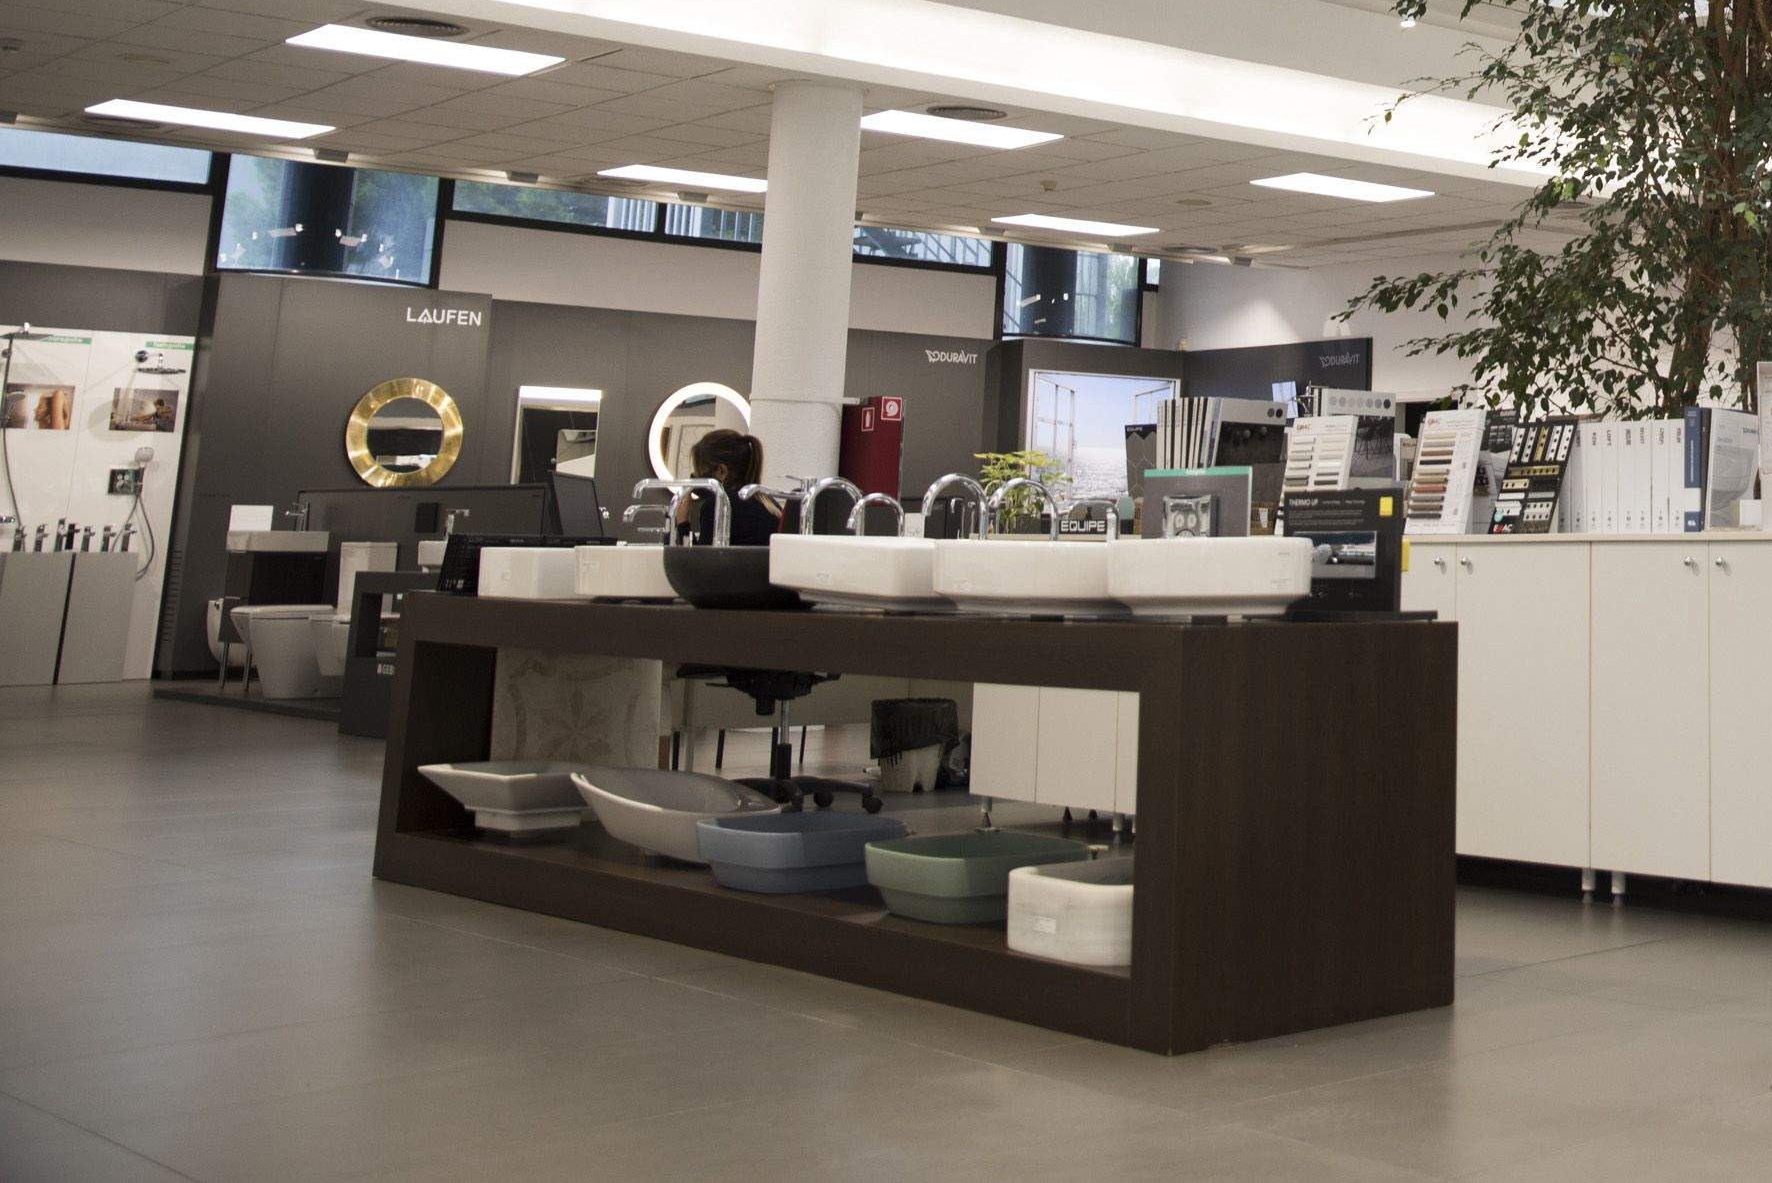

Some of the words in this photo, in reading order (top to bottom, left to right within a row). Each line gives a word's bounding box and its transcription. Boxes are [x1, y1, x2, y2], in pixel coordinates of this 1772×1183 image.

[406, 307, 482, 326] LAUFEN
[940, 350, 978, 364] DURAVIT
[1061, 520, 1105, 532] EQUIPE
